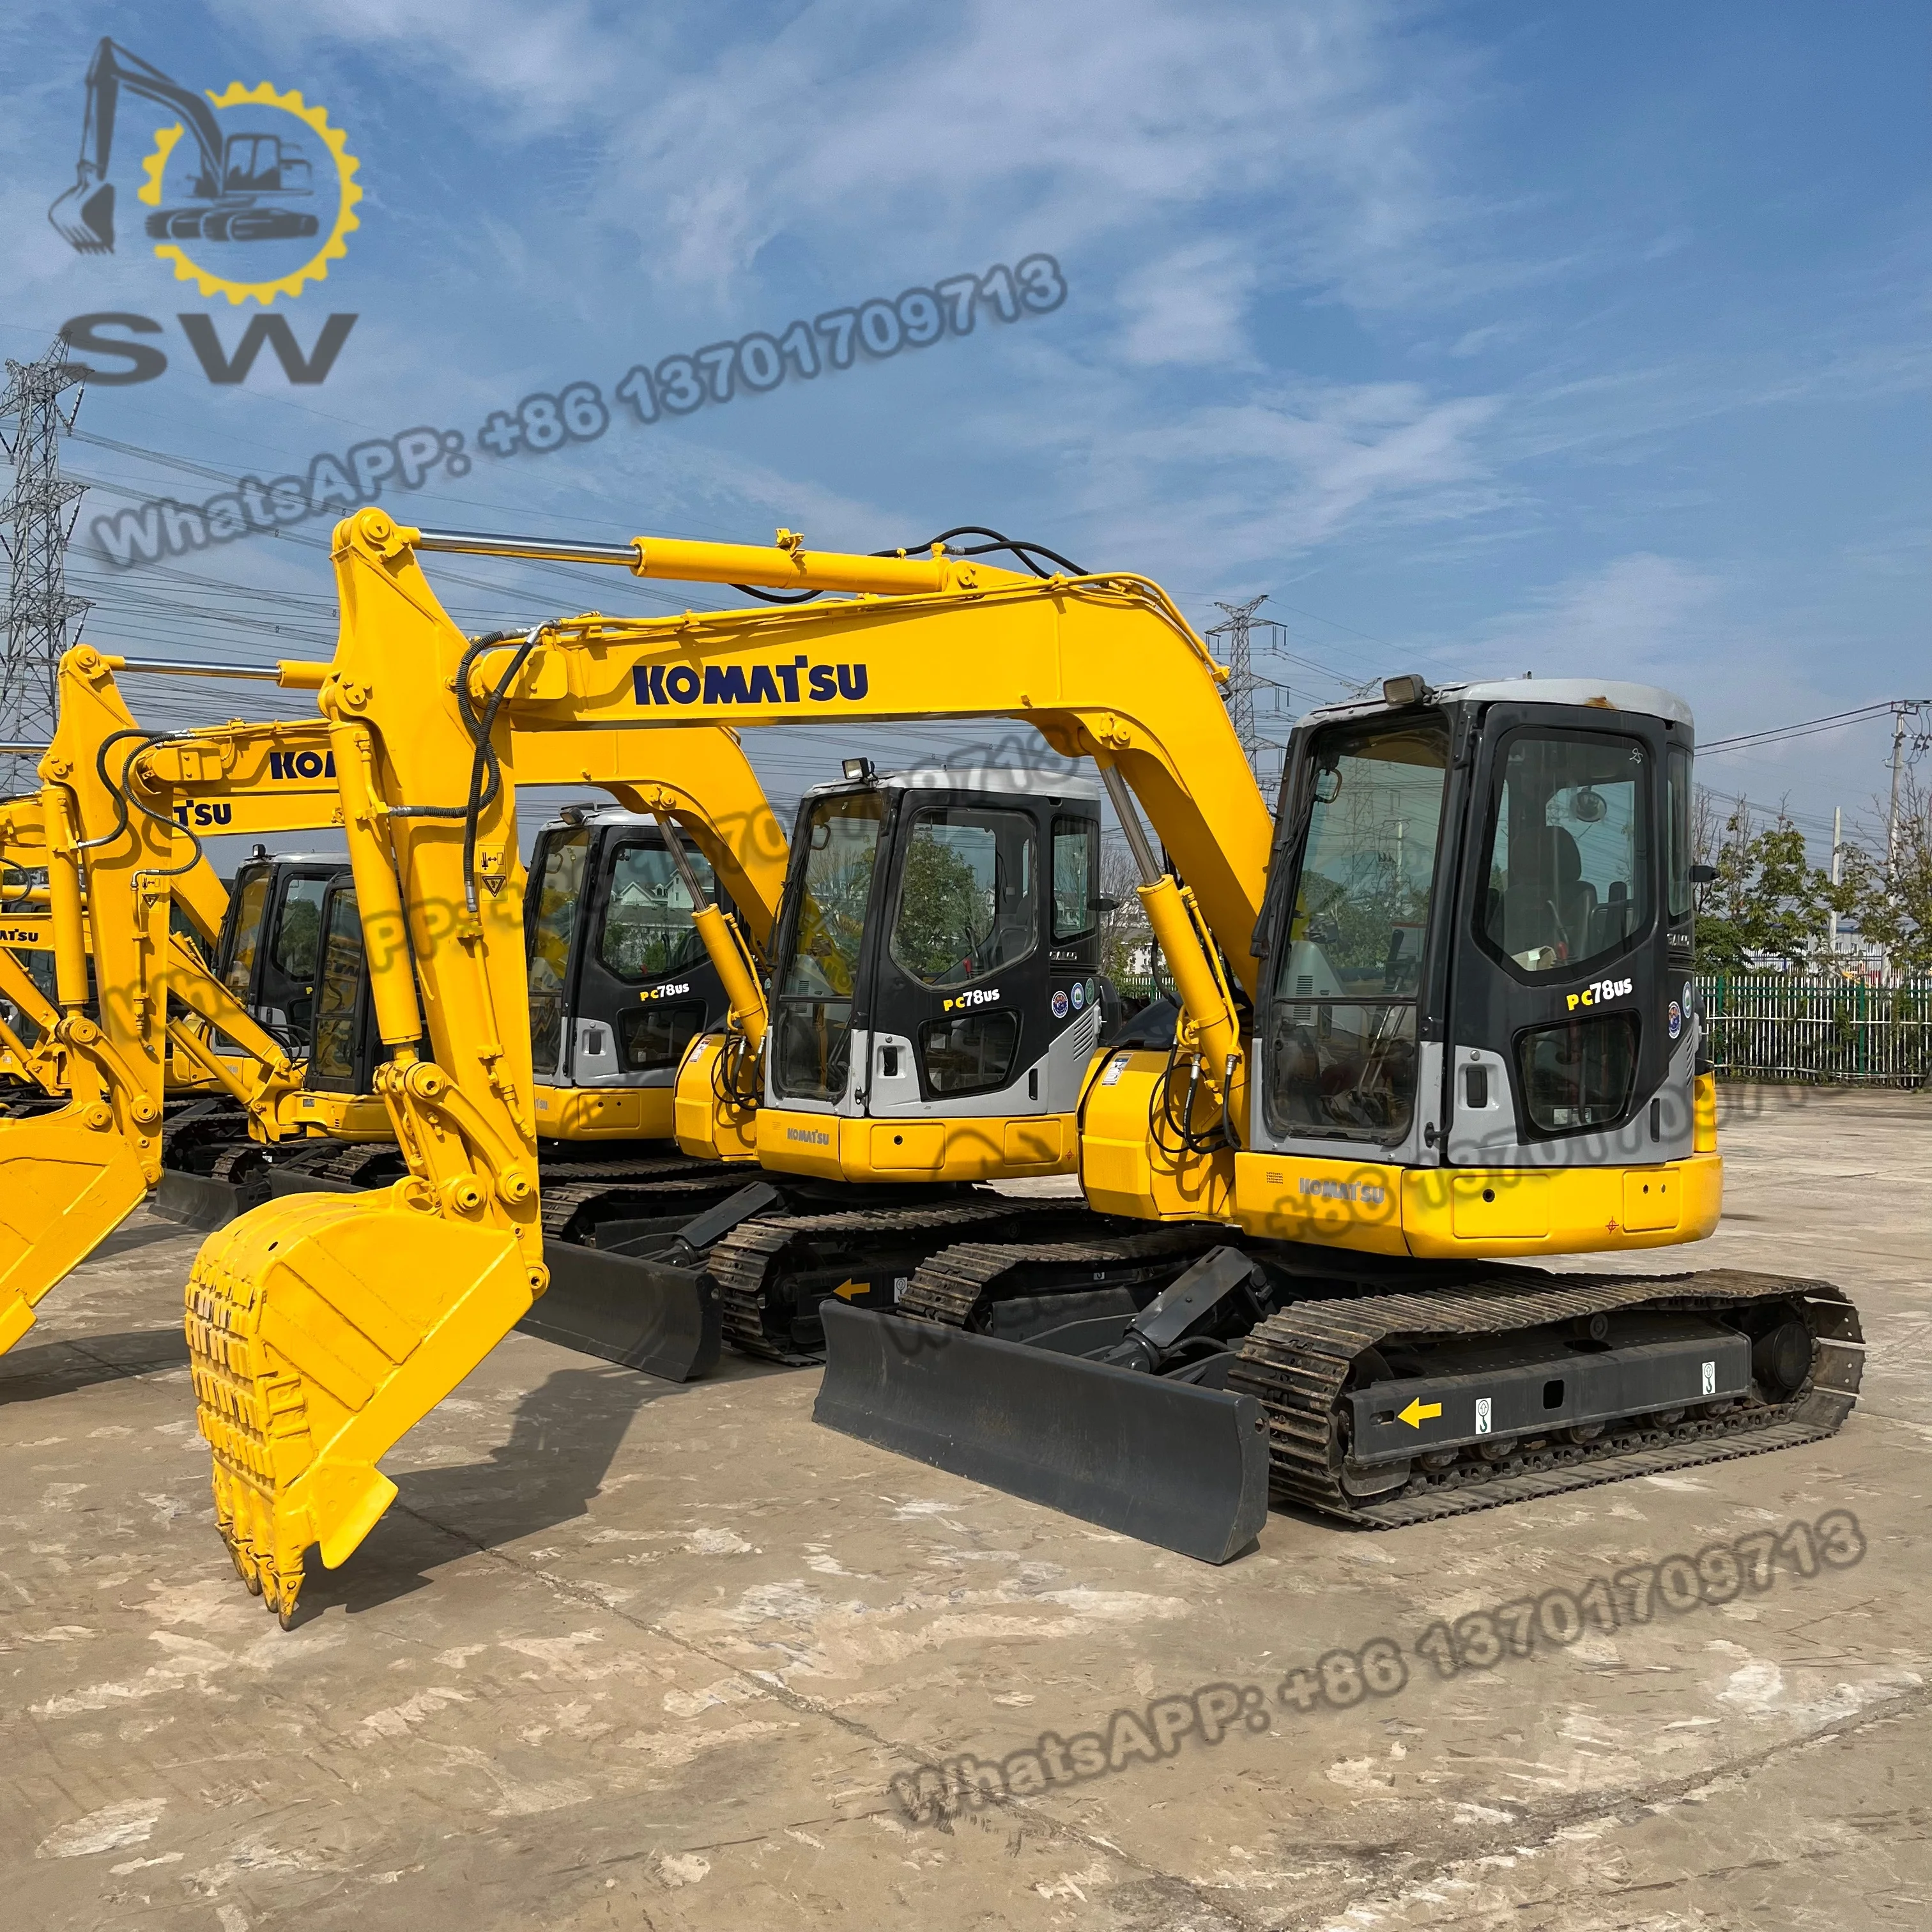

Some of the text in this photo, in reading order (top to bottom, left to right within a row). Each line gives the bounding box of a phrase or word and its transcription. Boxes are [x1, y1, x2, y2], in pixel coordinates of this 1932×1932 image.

[632, 655, 869, 705] KOMATSU
[270, 751, 337, 779] KO
[787, 1128, 829, 1145] KOMATSU
[1299, 1177, 1384, 1204] KOMATSU
